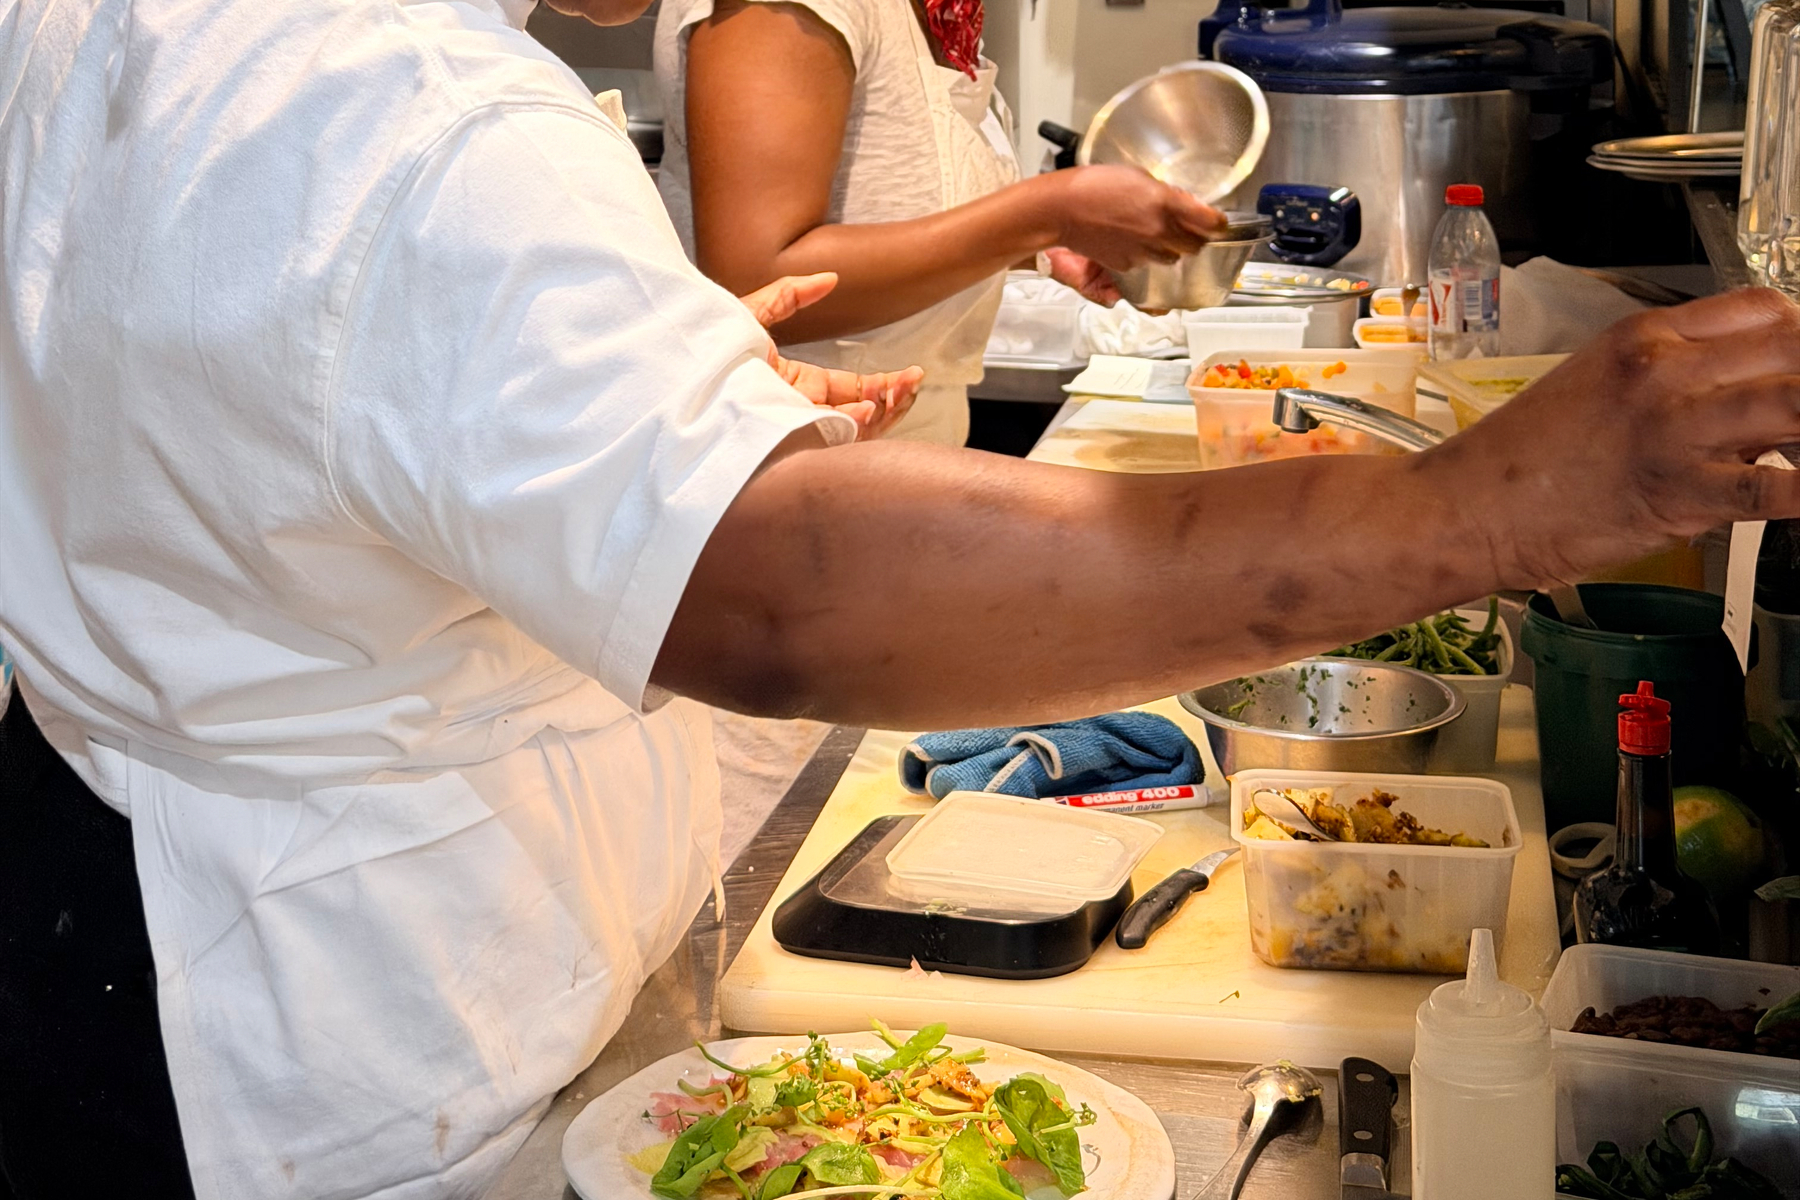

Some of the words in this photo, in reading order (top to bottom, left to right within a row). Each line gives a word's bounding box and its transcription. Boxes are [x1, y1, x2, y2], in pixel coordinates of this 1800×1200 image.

[1081, 791, 1138, 805] edding
[1141, 786, 1180, 799] 400
[1135, 802, 1165, 812] marker
